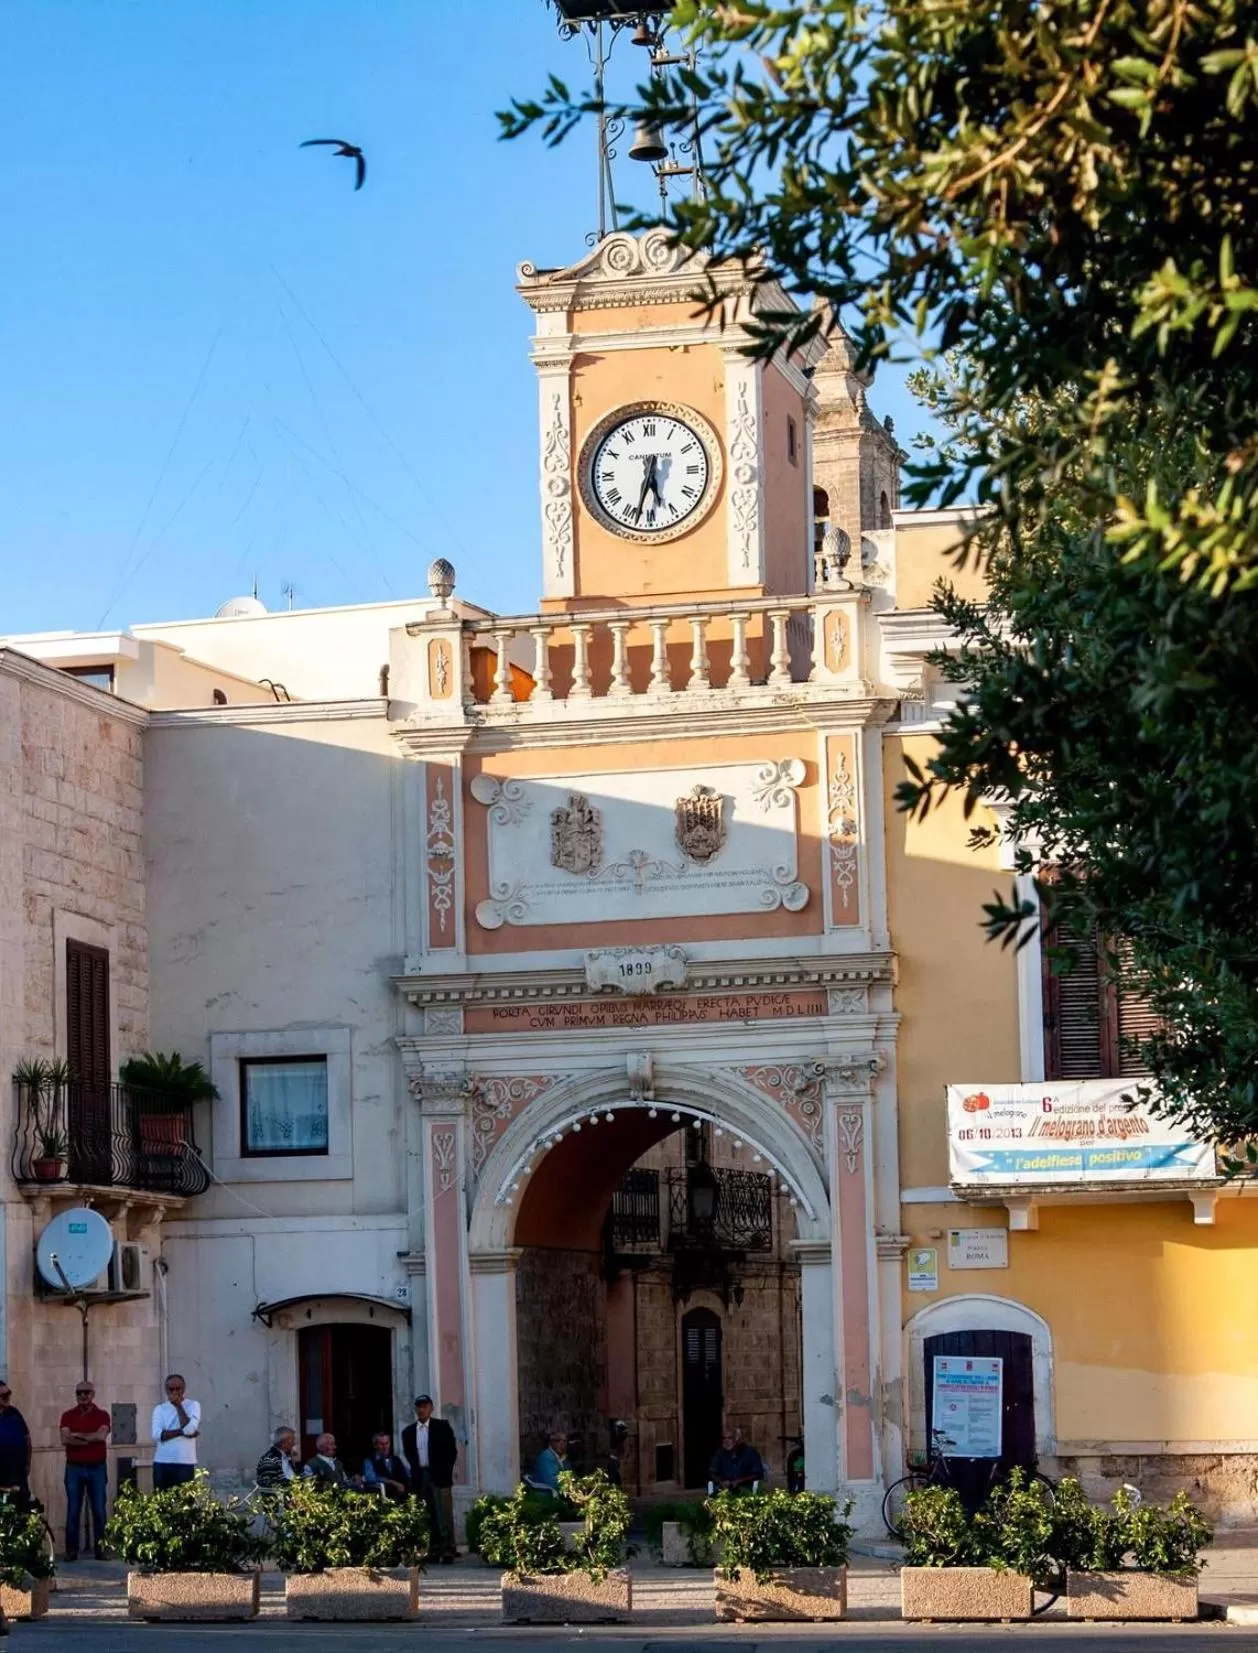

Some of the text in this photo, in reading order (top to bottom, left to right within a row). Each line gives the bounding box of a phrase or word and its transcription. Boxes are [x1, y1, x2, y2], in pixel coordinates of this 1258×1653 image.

[643, 423, 656, 437] XII
[667, 428, 674, 440] I
[621, 430, 635, 445] XI
[607, 449, 620, 460] X
[680, 443, 694, 454] II
[686, 465, 699, 475] III
[606, 487, 622, 506] VIII
[646, 509, 656, 522] VI
[668, 503, 678, 515] V
[493, 1007, 531, 1020] PORTA
[697, 996, 741, 1009] ERECTA
[530, 1016, 555, 1027] CVM
[564, 1014, 605, 1026] PRIMVM
[720, 1006, 759, 1018] HABET
[1053, 1104, 1091, 1114] edizione
[1092, 1103, 1106, 1113] del
[1040, 1114, 1095, 1141] melograno
[1096, 1112, 1149, 1141] d'argento
